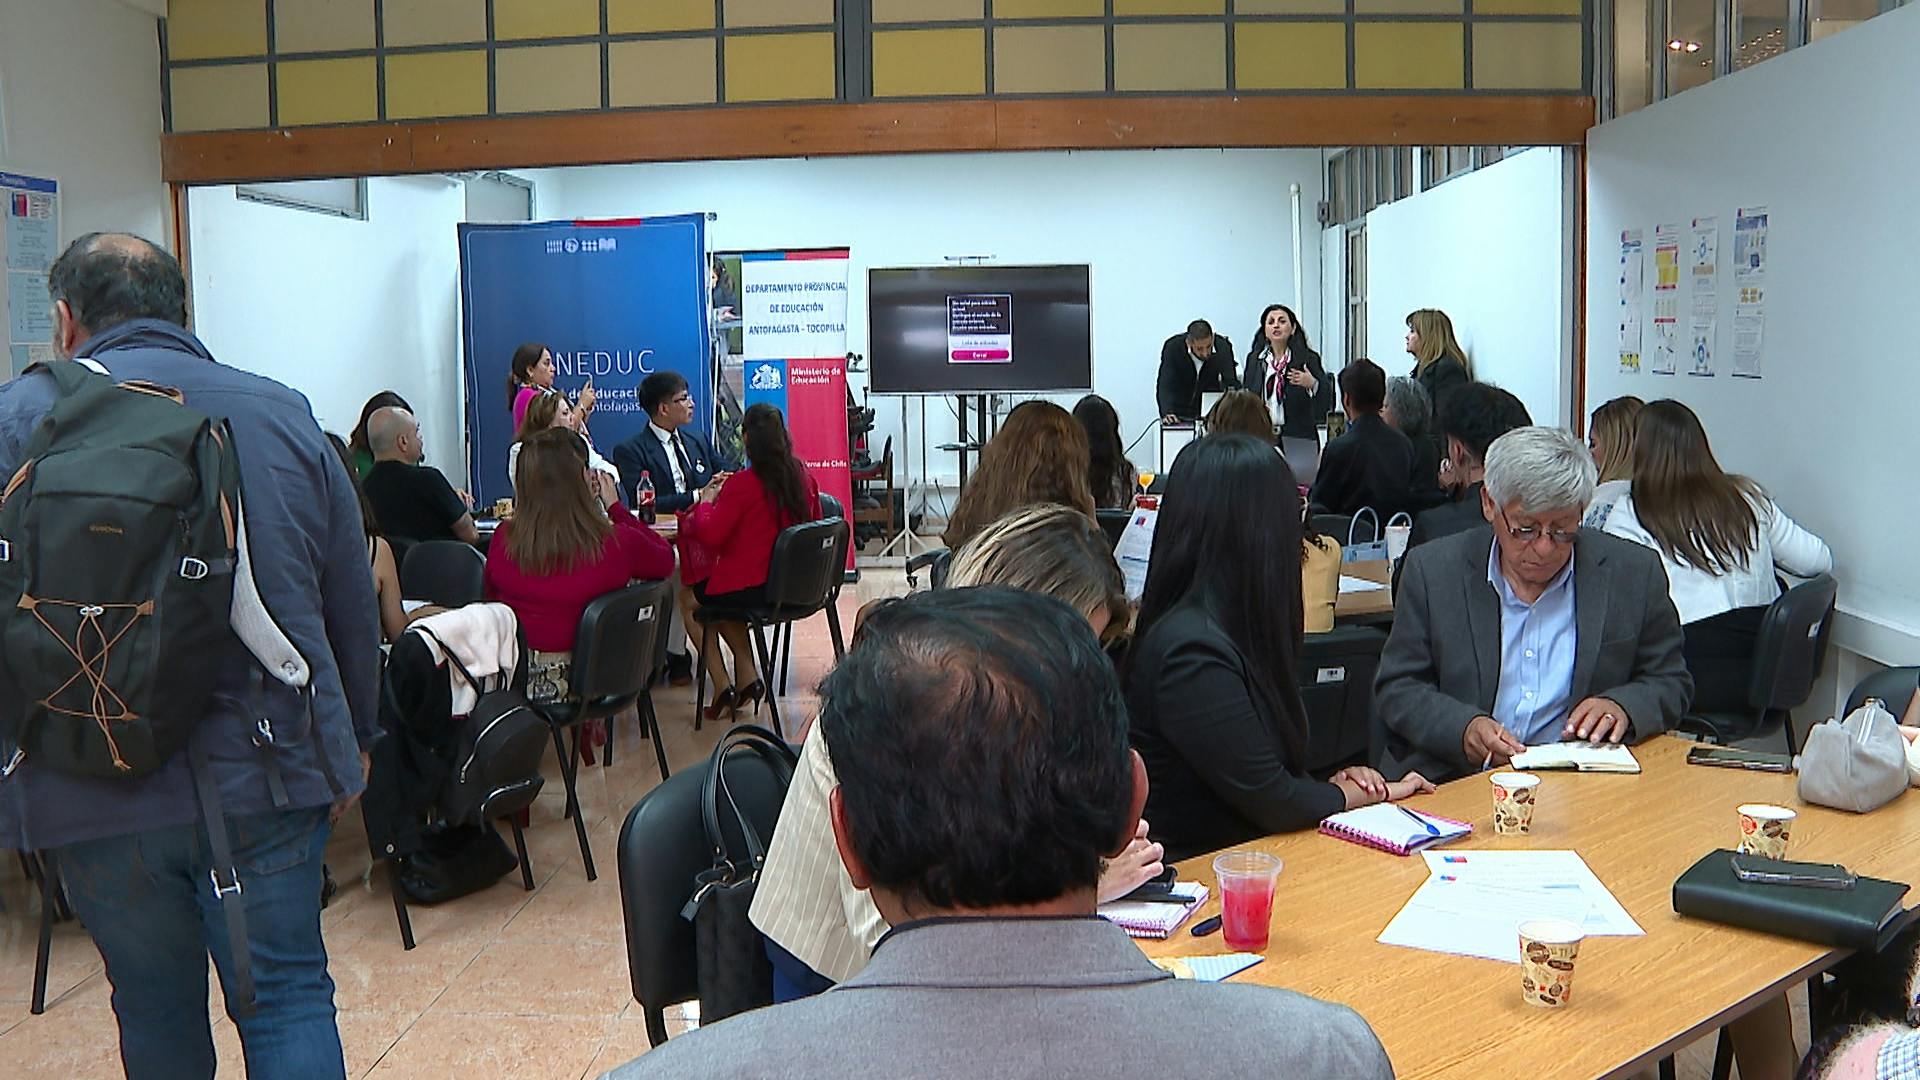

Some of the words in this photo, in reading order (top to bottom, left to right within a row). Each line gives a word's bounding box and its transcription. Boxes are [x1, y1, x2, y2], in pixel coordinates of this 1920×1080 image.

[745, 284, 803, 294] DEPARTAMENTO
[804, 282, 848, 292] PROVINCIAL
[770, 304, 780, 313] DE
[781, 302, 824, 313] EDUCACIÓN
[749, 325, 800, 335] ANTOFAGASTA
[807, 323, 846, 333] TOCOPILLA
[555, 350, 655, 375] NEDUC
[791, 367, 830, 376] Ministerio
[831, 366, 841, 376] de
[791, 376, 830, 385] Educación
[595, 386, 640, 400] ducaci
[822, 459, 830, 468] de
[831, 459, 847, 468] Chile
